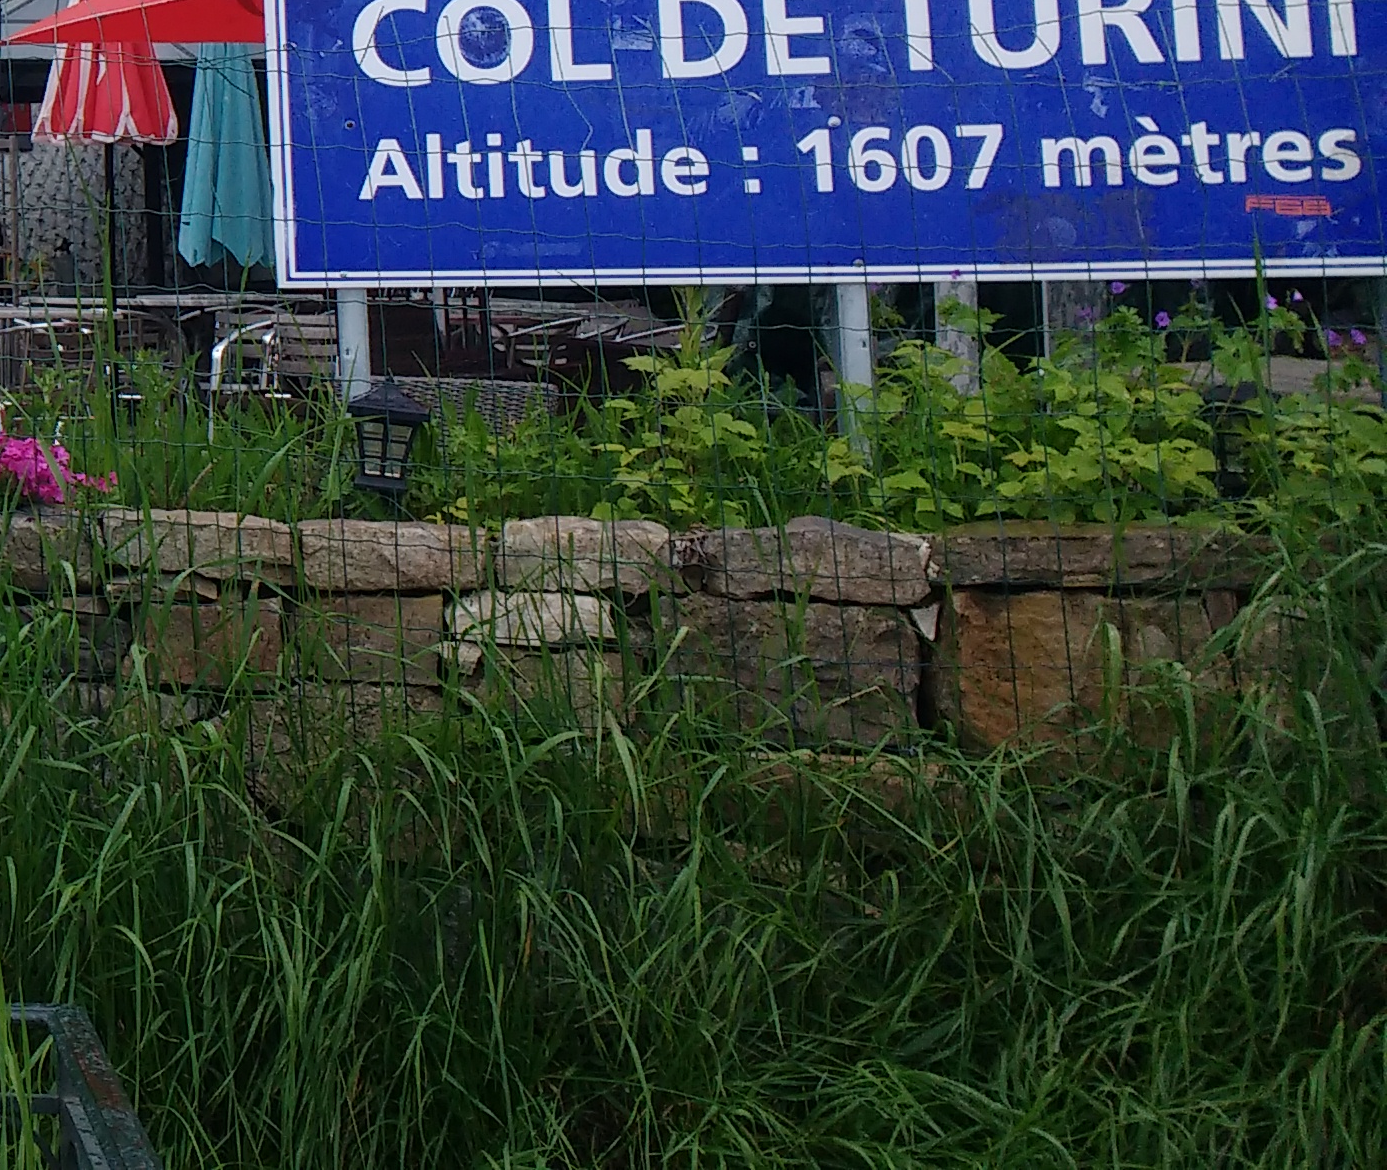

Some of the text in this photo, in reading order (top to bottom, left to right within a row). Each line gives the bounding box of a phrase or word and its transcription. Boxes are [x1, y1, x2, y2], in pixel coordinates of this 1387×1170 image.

[358, 129, 711, 201] Altitude
[797, 124, 1004, 194] 1607
[1041, 117, 1363, 188] mètres
